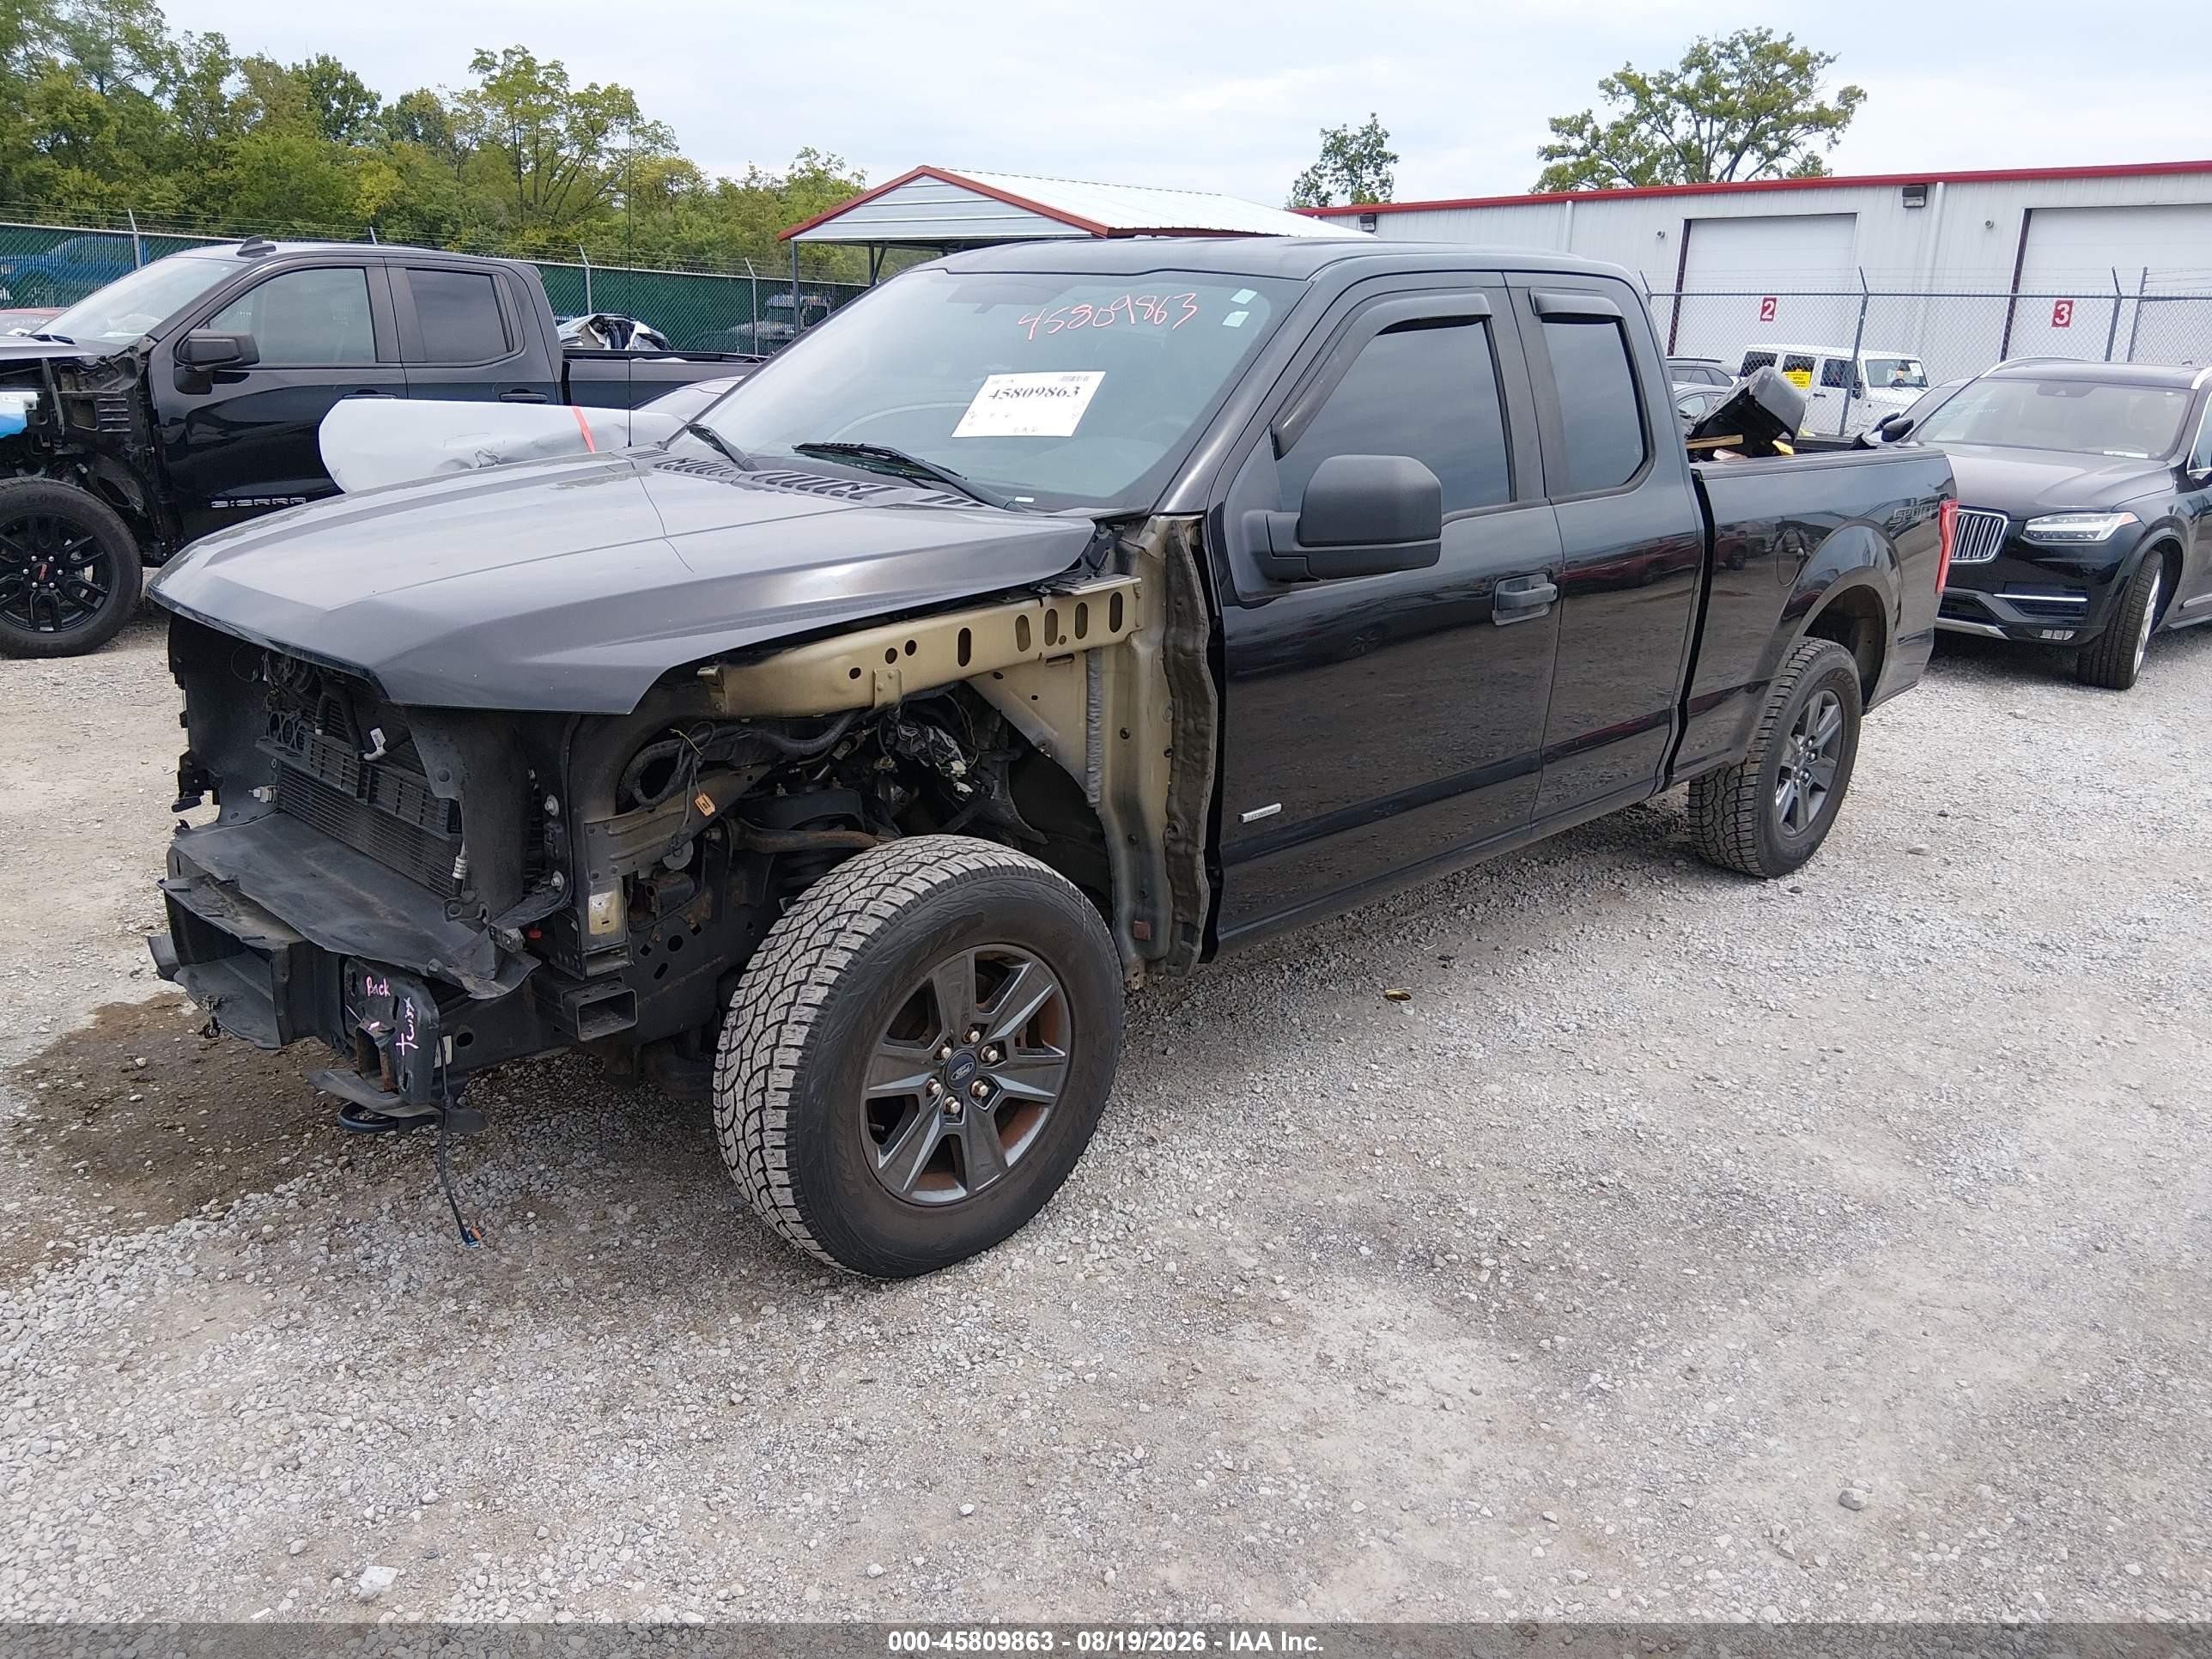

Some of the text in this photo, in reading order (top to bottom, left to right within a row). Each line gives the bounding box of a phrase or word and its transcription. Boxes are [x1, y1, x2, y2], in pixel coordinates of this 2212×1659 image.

[1018, 292, 1200, 341] 45809863
[1761, 300, 1775, 319] 2
[2054, 303, 2070, 325] 3
[988, 386, 1081, 400] 45809863
[210, 497, 307, 508] SIERRA
